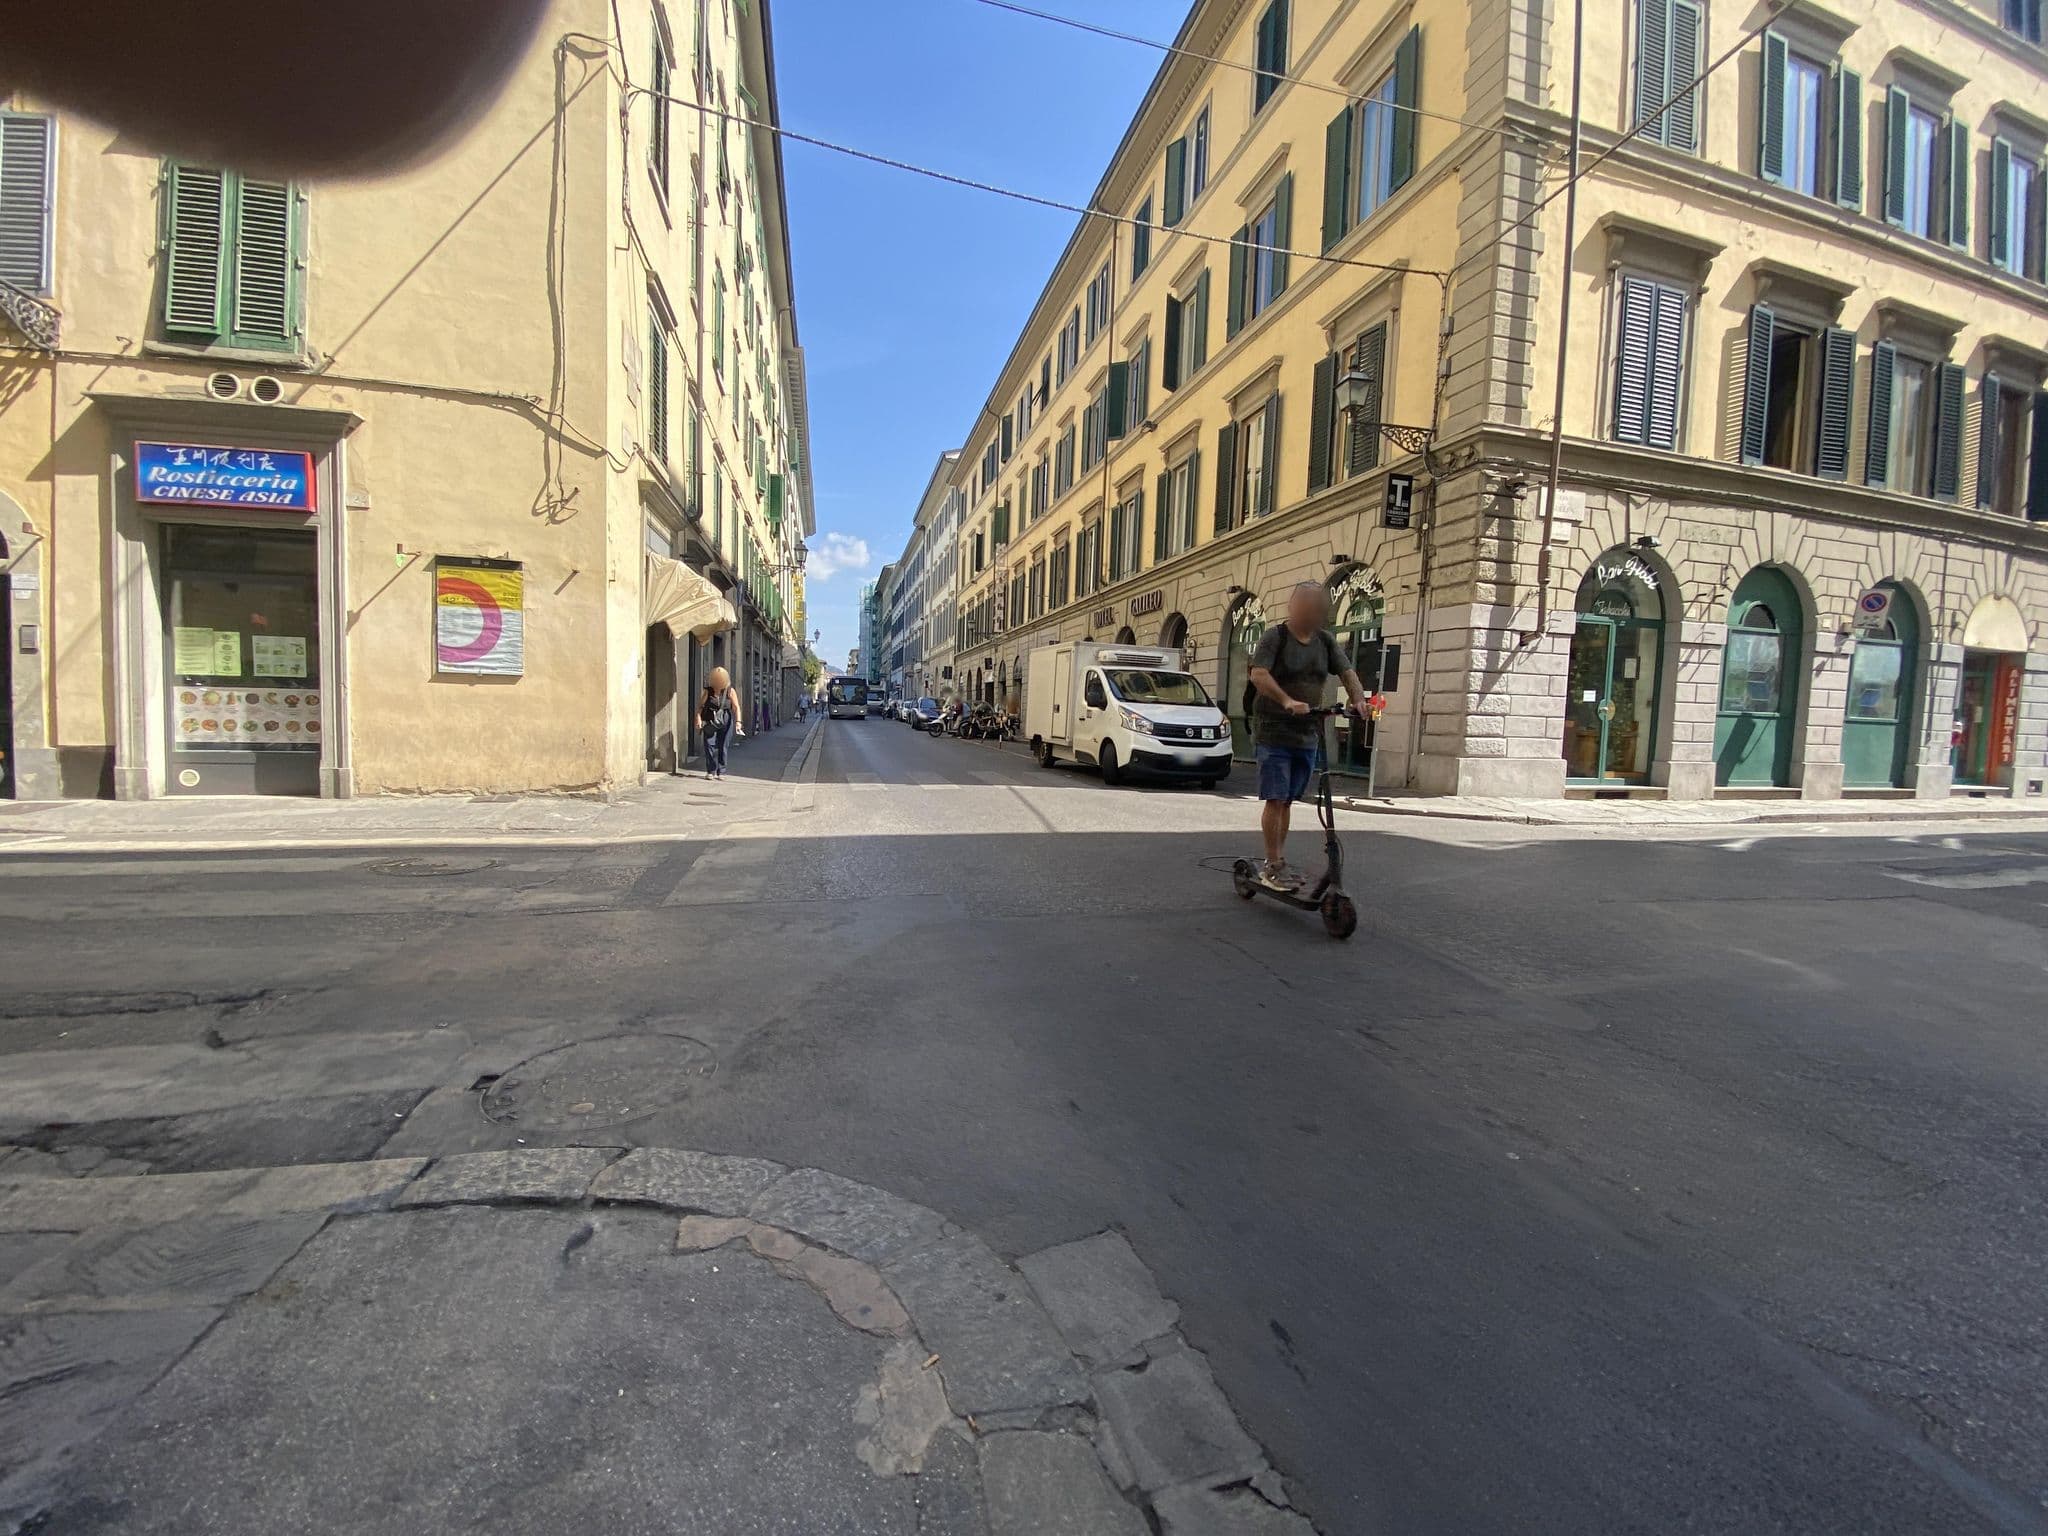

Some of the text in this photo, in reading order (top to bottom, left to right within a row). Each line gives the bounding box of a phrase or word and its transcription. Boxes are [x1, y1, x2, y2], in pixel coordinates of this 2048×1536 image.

[149, 466, 298, 490] Rosticceria
[153, 486, 293, 504] CINESE ASIA
[1598, 561, 1622, 588] Bar
[1131, 589, 1163, 616] GALILEO
